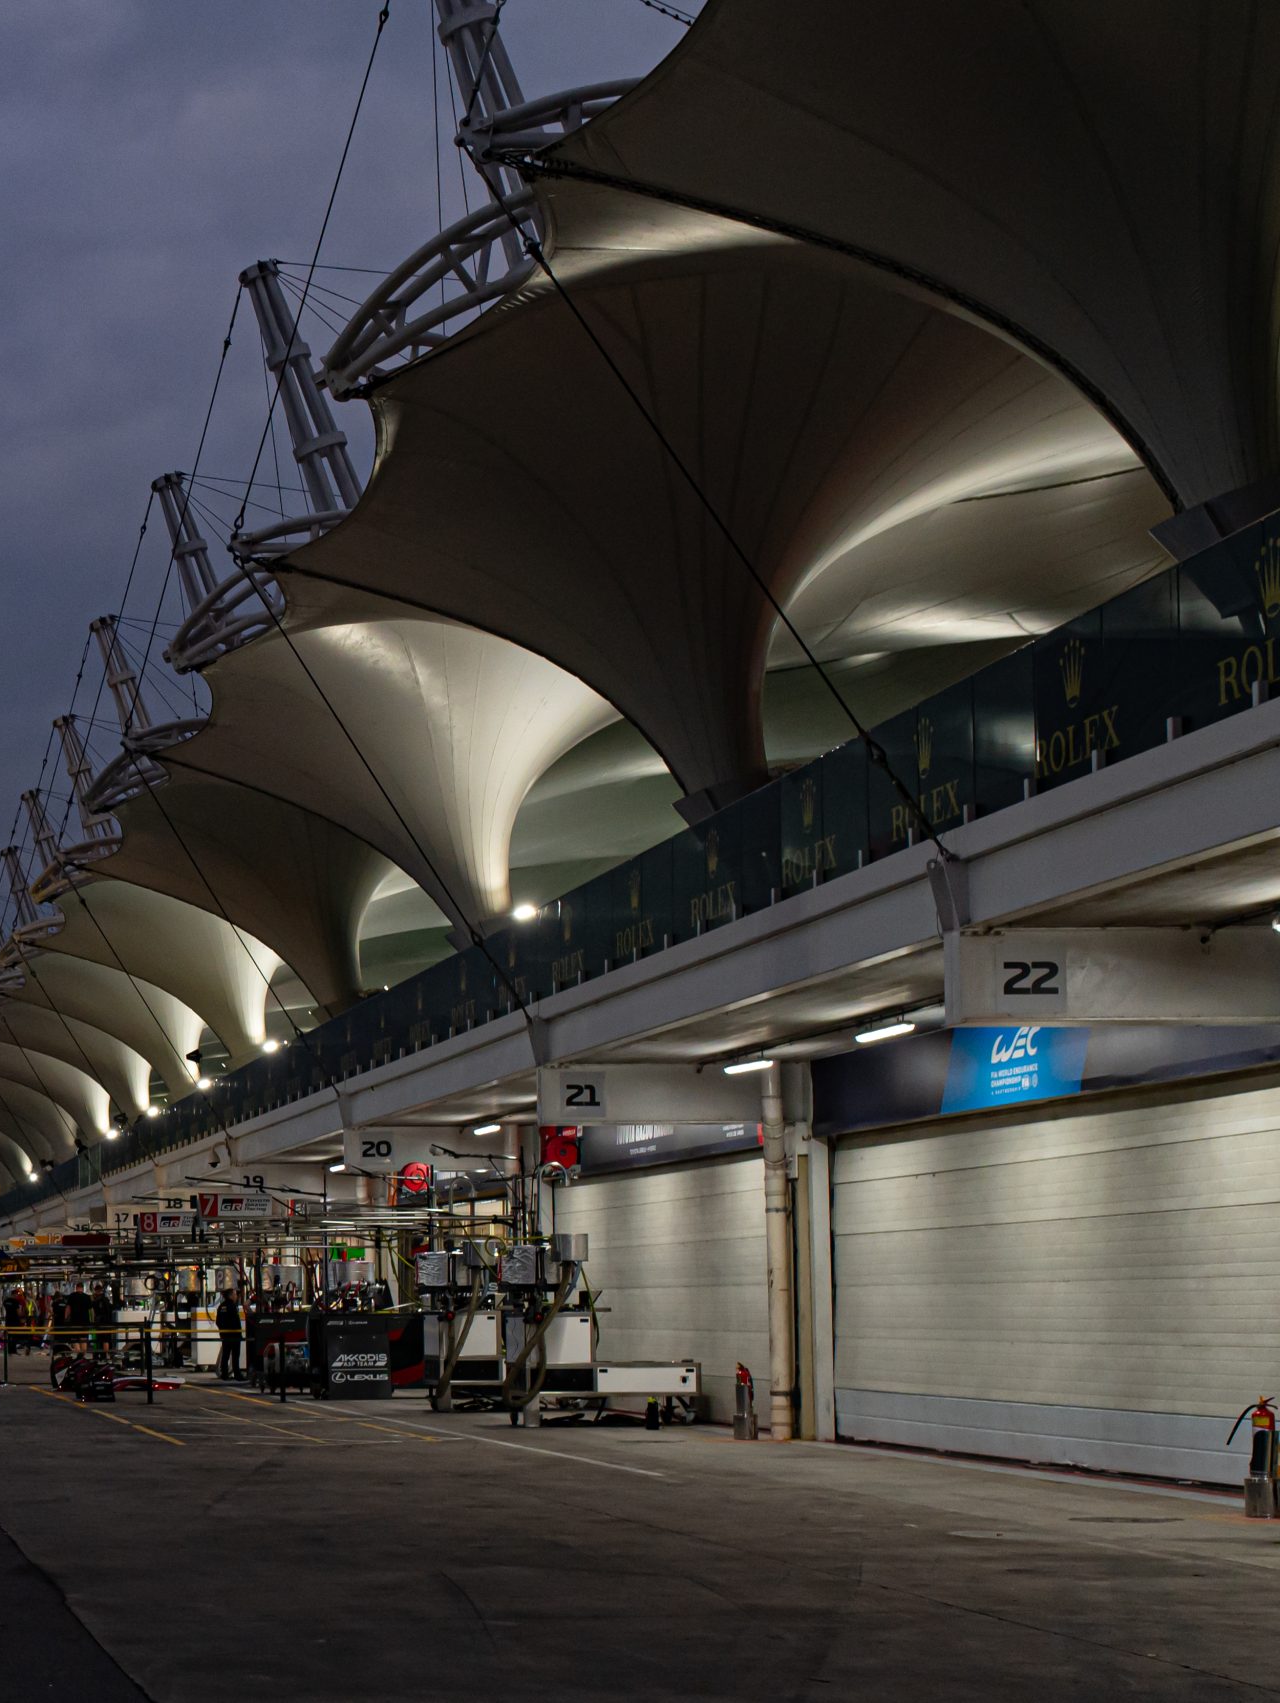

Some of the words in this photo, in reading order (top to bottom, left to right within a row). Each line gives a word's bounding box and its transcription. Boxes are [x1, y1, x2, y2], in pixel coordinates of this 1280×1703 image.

[1034, 704, 1121, 779] ROLEX
[782, 833, 837, 888] ROLEX
[691, 881, 736, 927] ROLEX
[616, 919, 655, 958] ROLEX
[1003, 962, 1059, 995] 22
[991, 1026, 1041, 1065] WEC
[566, 1084, 600, 1106] 21
[362, 1141, 392, 1157] 20
[243, 1175, 265, 1193] 19
[165, 1198, 183, 1209] 18
[202, 1194, 216, 1217] 7
[221, 1202, 242, 1211] GR
[115, 1213, 129, 1223] 17
[143, 1213, 155, 1232] 8
[160, 1219, 180, 1228] GR
[336, 1353, 388, 1361] AKKODIS
